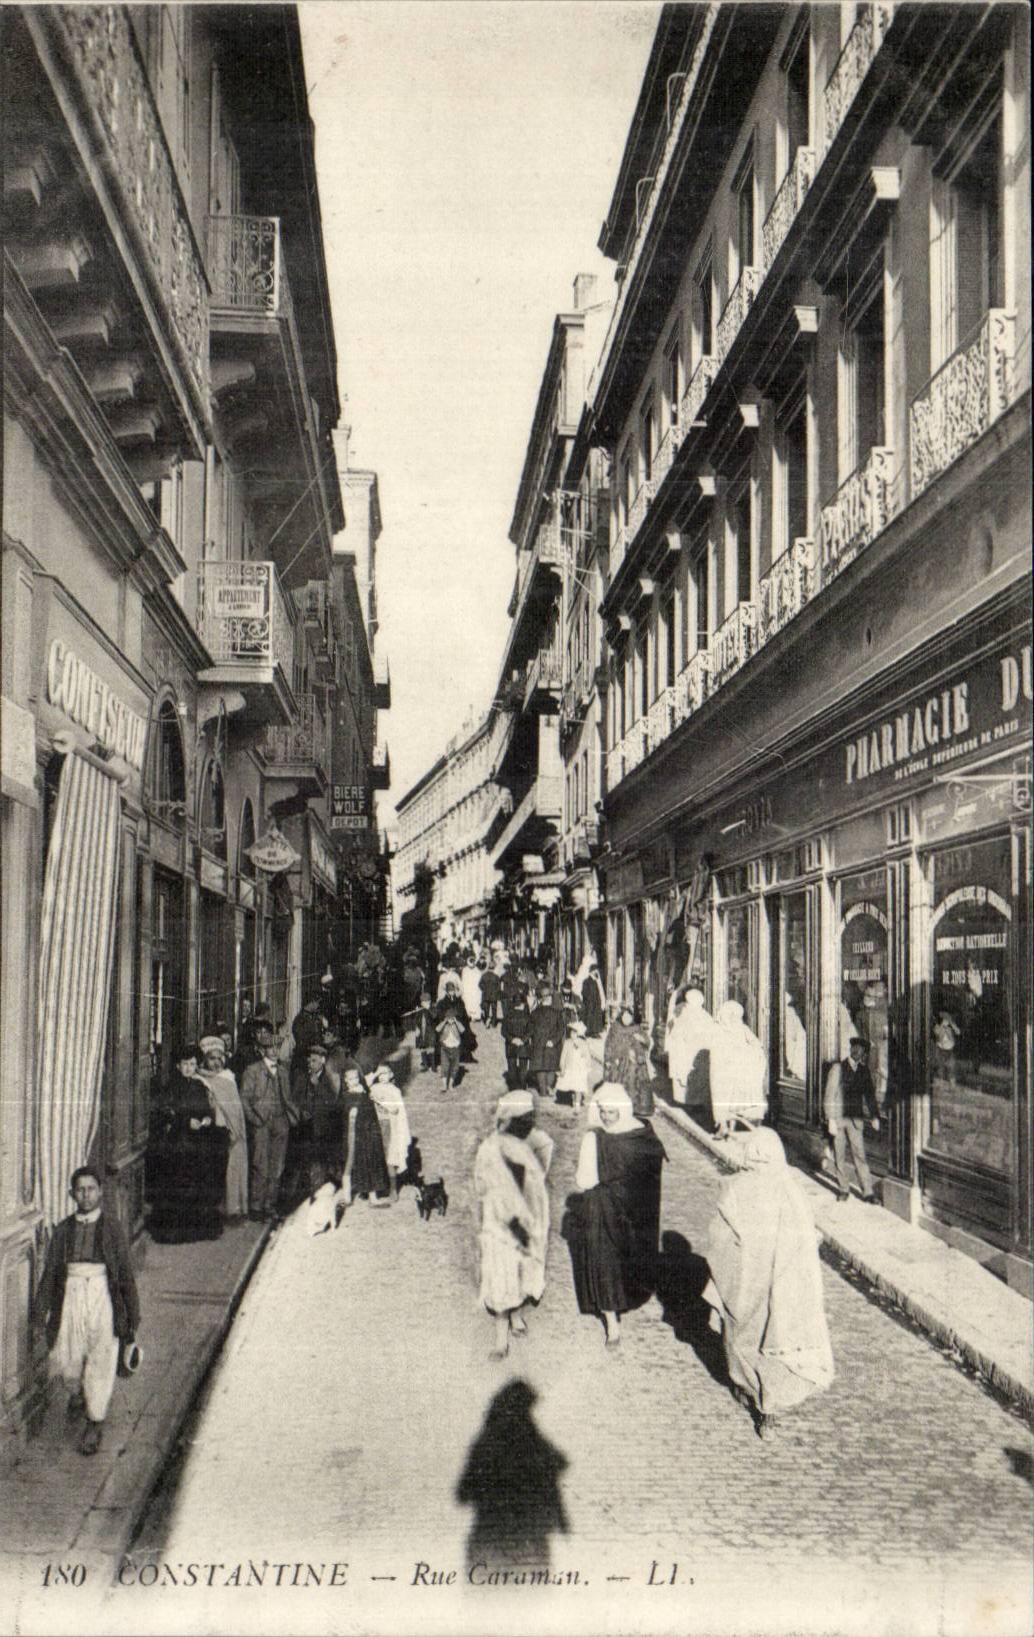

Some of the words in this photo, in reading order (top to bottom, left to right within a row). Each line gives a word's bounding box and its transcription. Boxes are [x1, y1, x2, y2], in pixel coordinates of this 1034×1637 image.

[846, 682, 969, 784] PHARMACIE
[334, 786, 366, 799] BIERE
[333, 800, 366, 814] WOLF
[335, 817, 365, 827] DEPOT
[982, 969, 999, 984] PRIX
